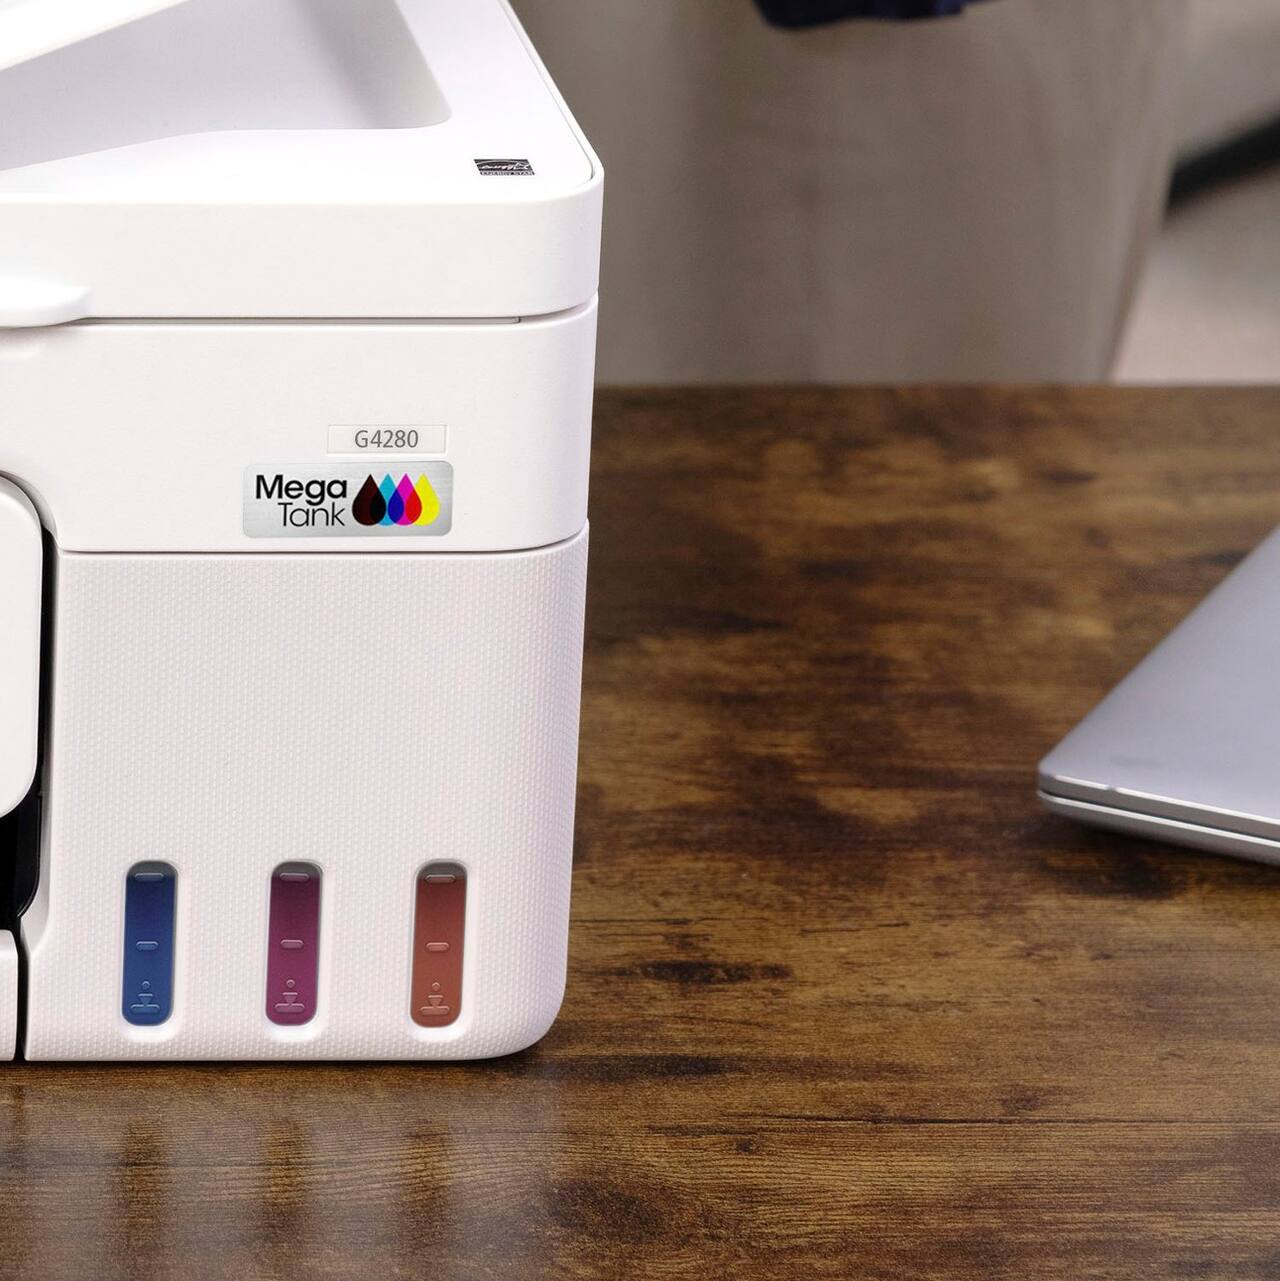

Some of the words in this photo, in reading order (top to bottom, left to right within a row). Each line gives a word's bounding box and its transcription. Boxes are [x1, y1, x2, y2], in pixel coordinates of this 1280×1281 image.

[354, 429, 419, 449] G4280
[255, 474, 348, 507] Mega
[277, 501, 346, 528] Tank
